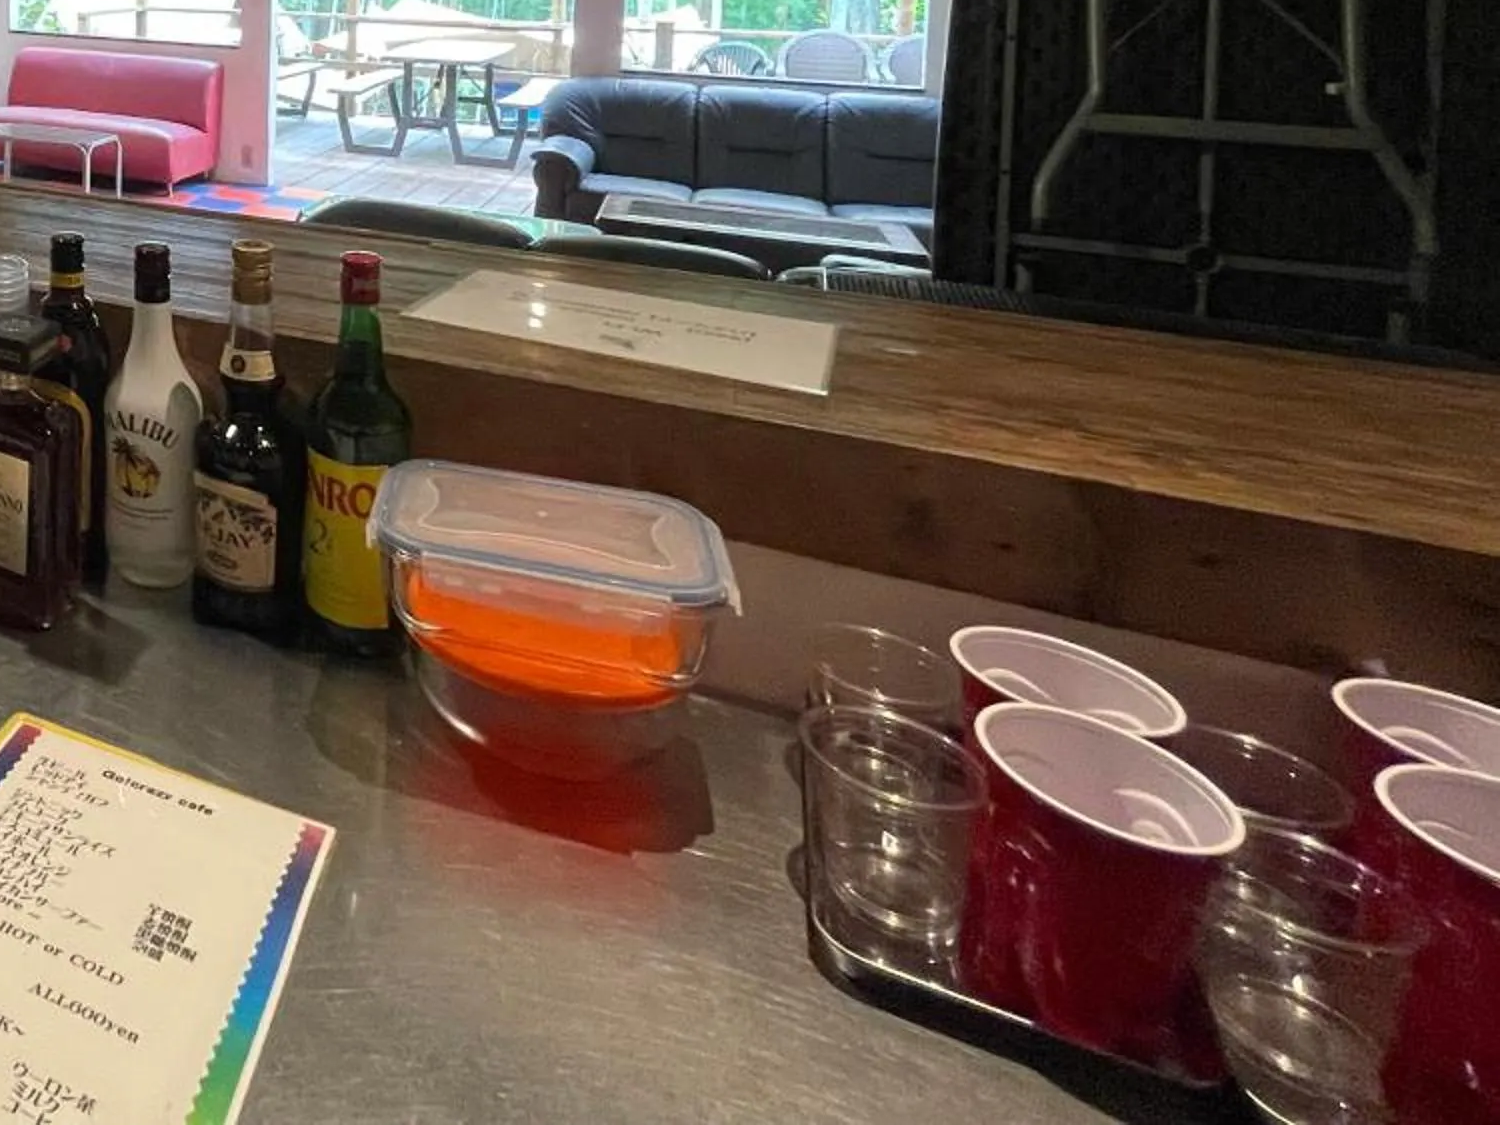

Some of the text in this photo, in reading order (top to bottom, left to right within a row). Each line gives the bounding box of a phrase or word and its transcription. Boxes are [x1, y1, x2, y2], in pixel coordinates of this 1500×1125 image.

[308, 472, 377, 519] NRO
[41, 942, 65, 957] or
[67, 952, 126, 987] COLD
[10, 1079, 60, 1113] ミルク
